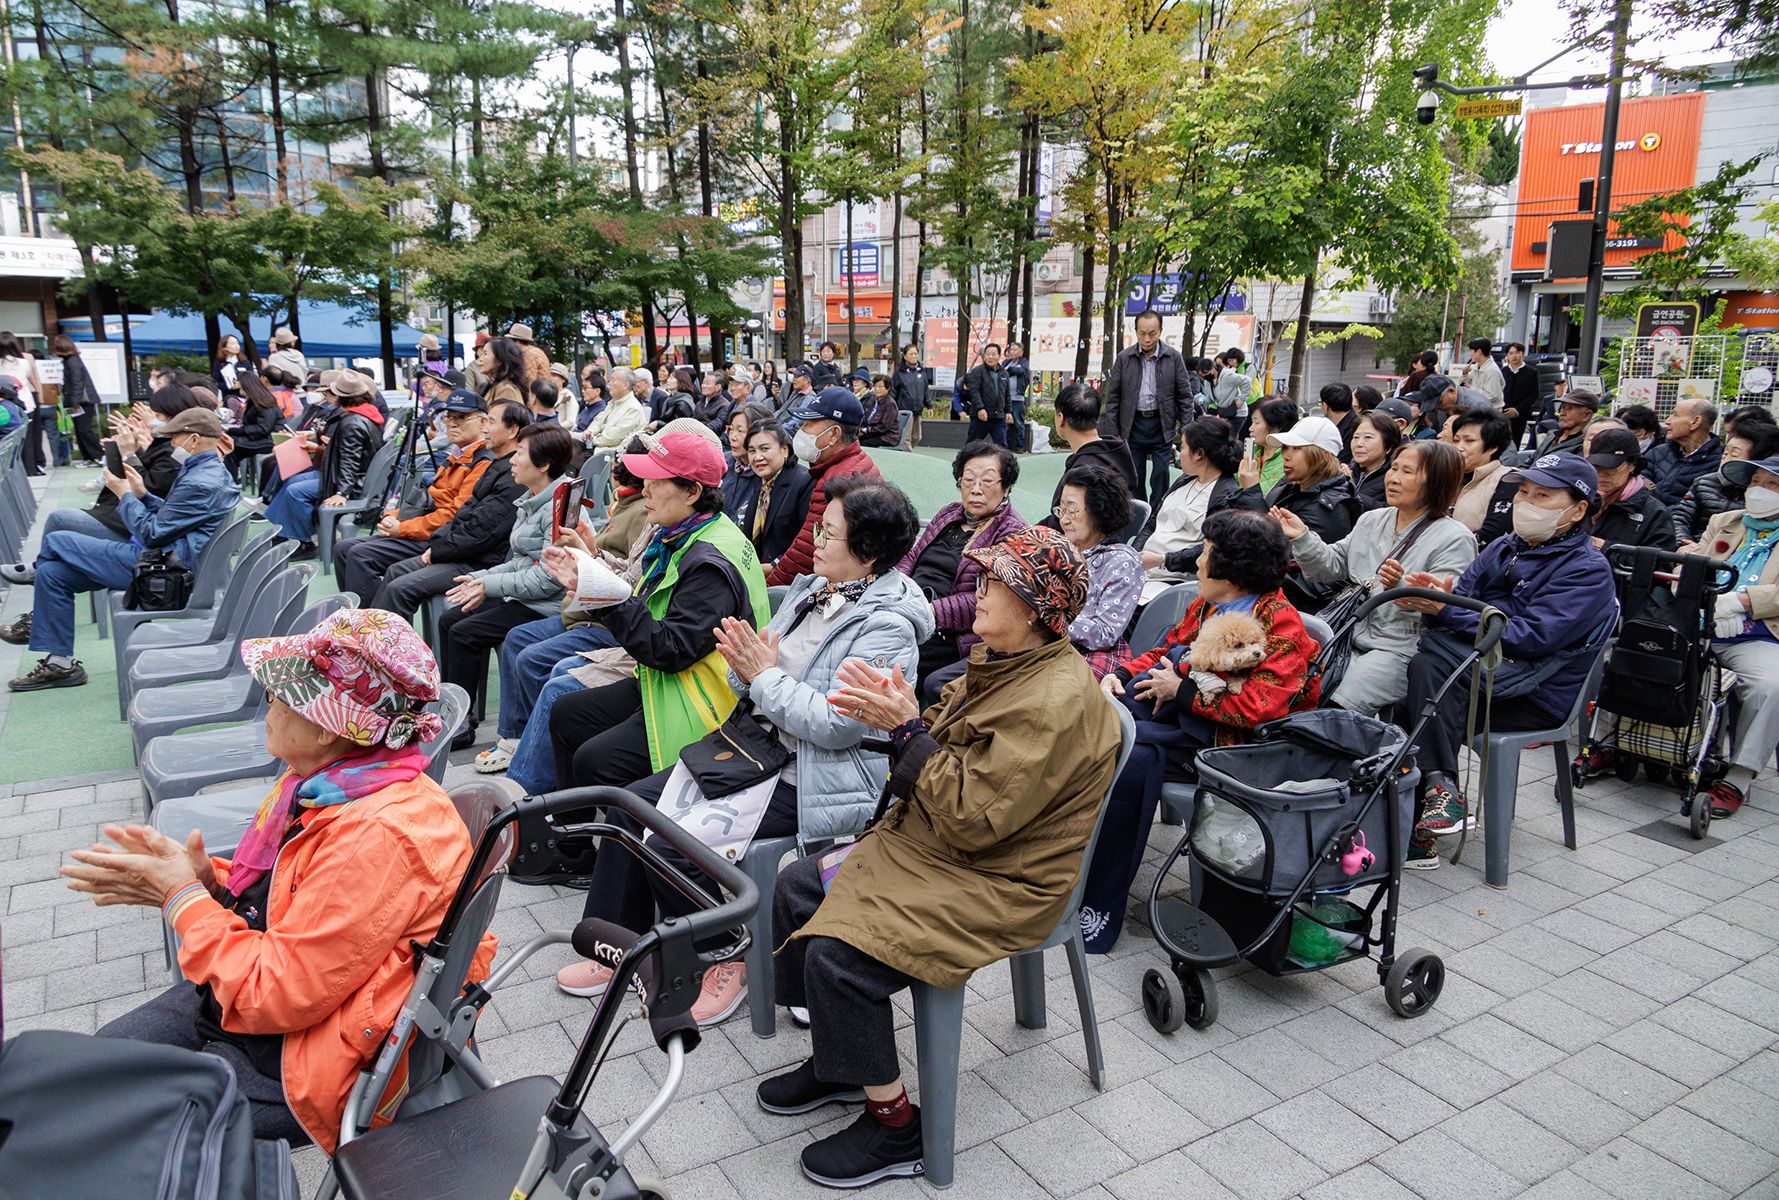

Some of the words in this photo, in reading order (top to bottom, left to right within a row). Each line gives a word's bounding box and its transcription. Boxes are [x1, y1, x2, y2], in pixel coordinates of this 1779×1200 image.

[1490, 103, 1505, 114] CCTV
[1561, 140, 1636, 155] T'Staon
[1652, 310, 1685, 319] 금연공원
